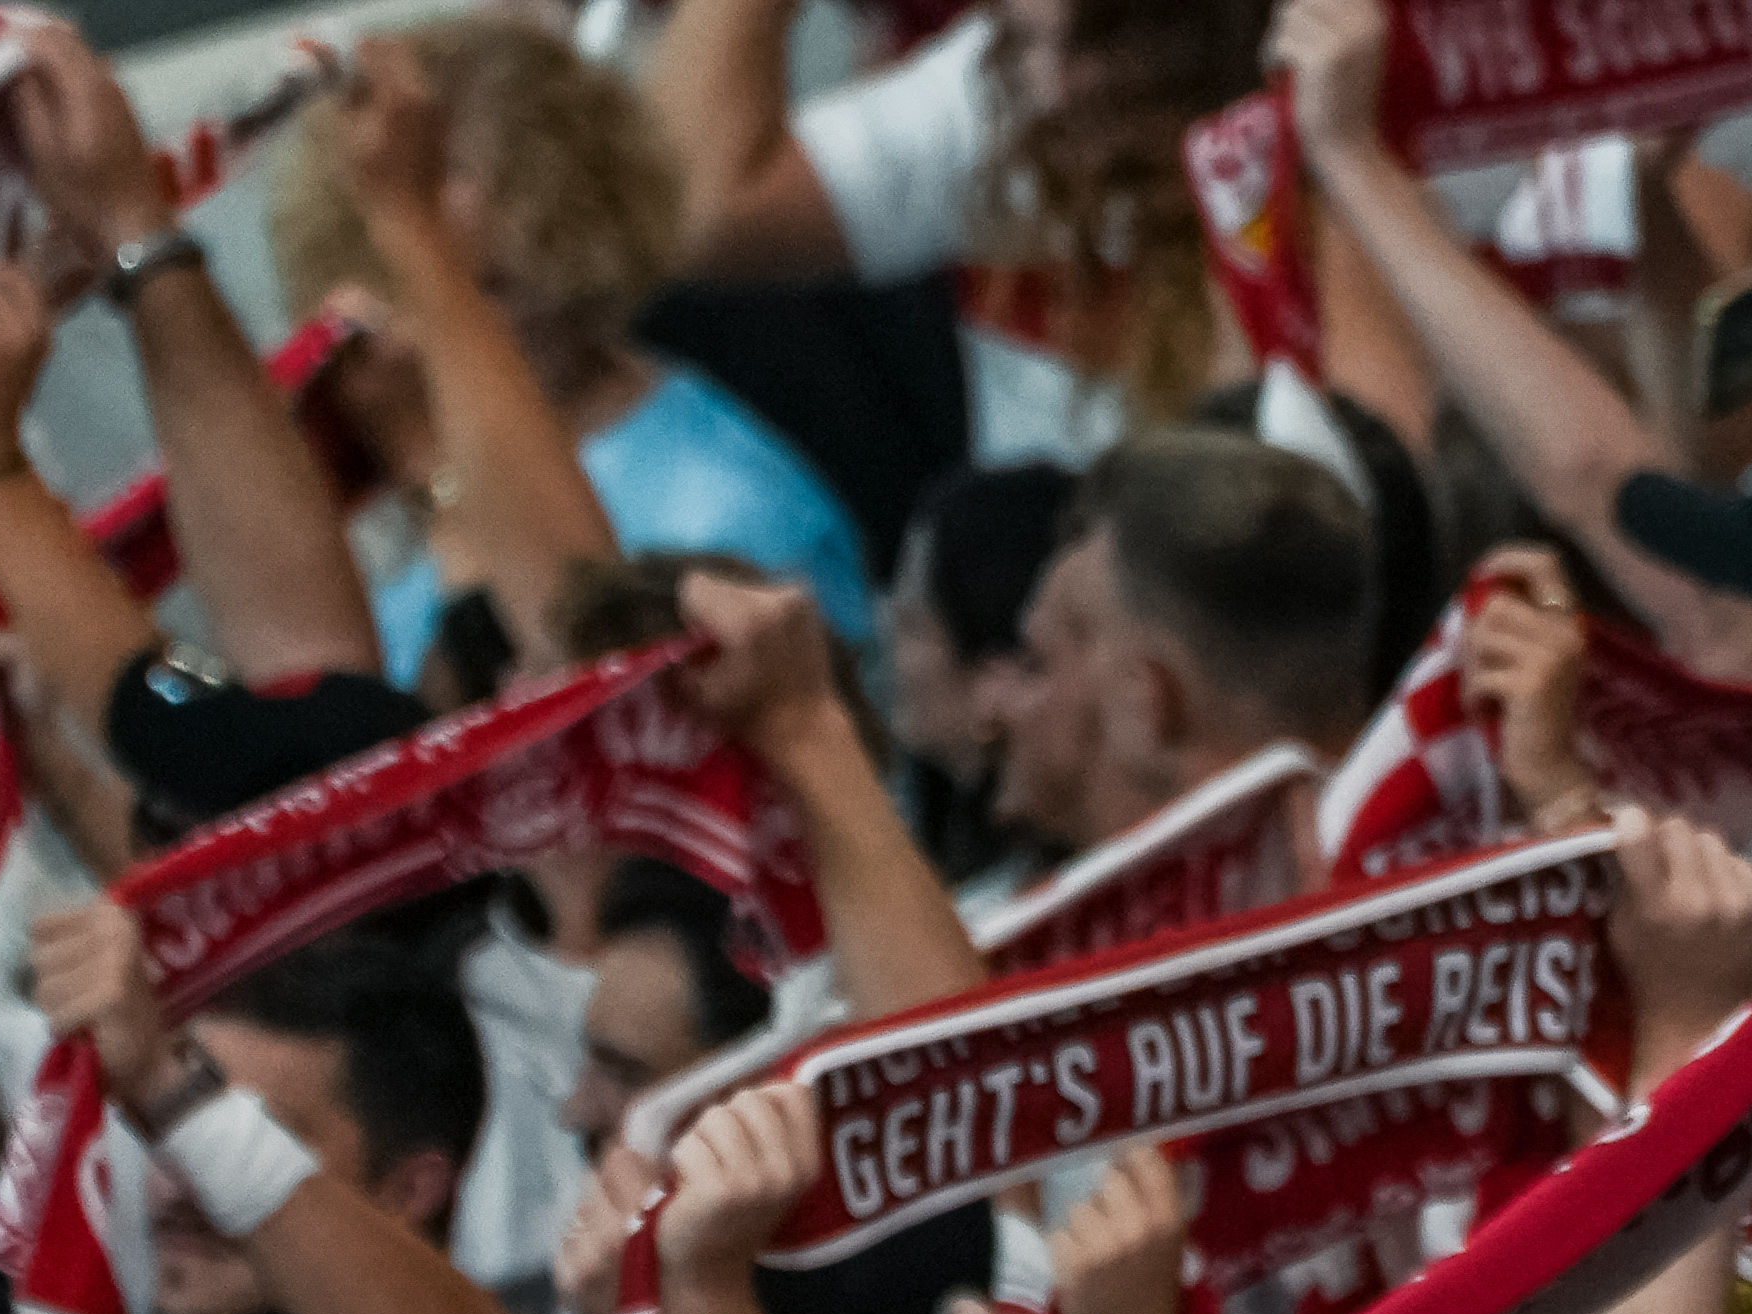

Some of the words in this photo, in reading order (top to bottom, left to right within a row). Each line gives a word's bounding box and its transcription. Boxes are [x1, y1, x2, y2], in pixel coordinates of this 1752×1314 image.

[831, 1036, 1100, 1222] GEHT'S
[1130, 996, 1270, 1128] AUF
[1292, 960, 1406, 1081] DIE
